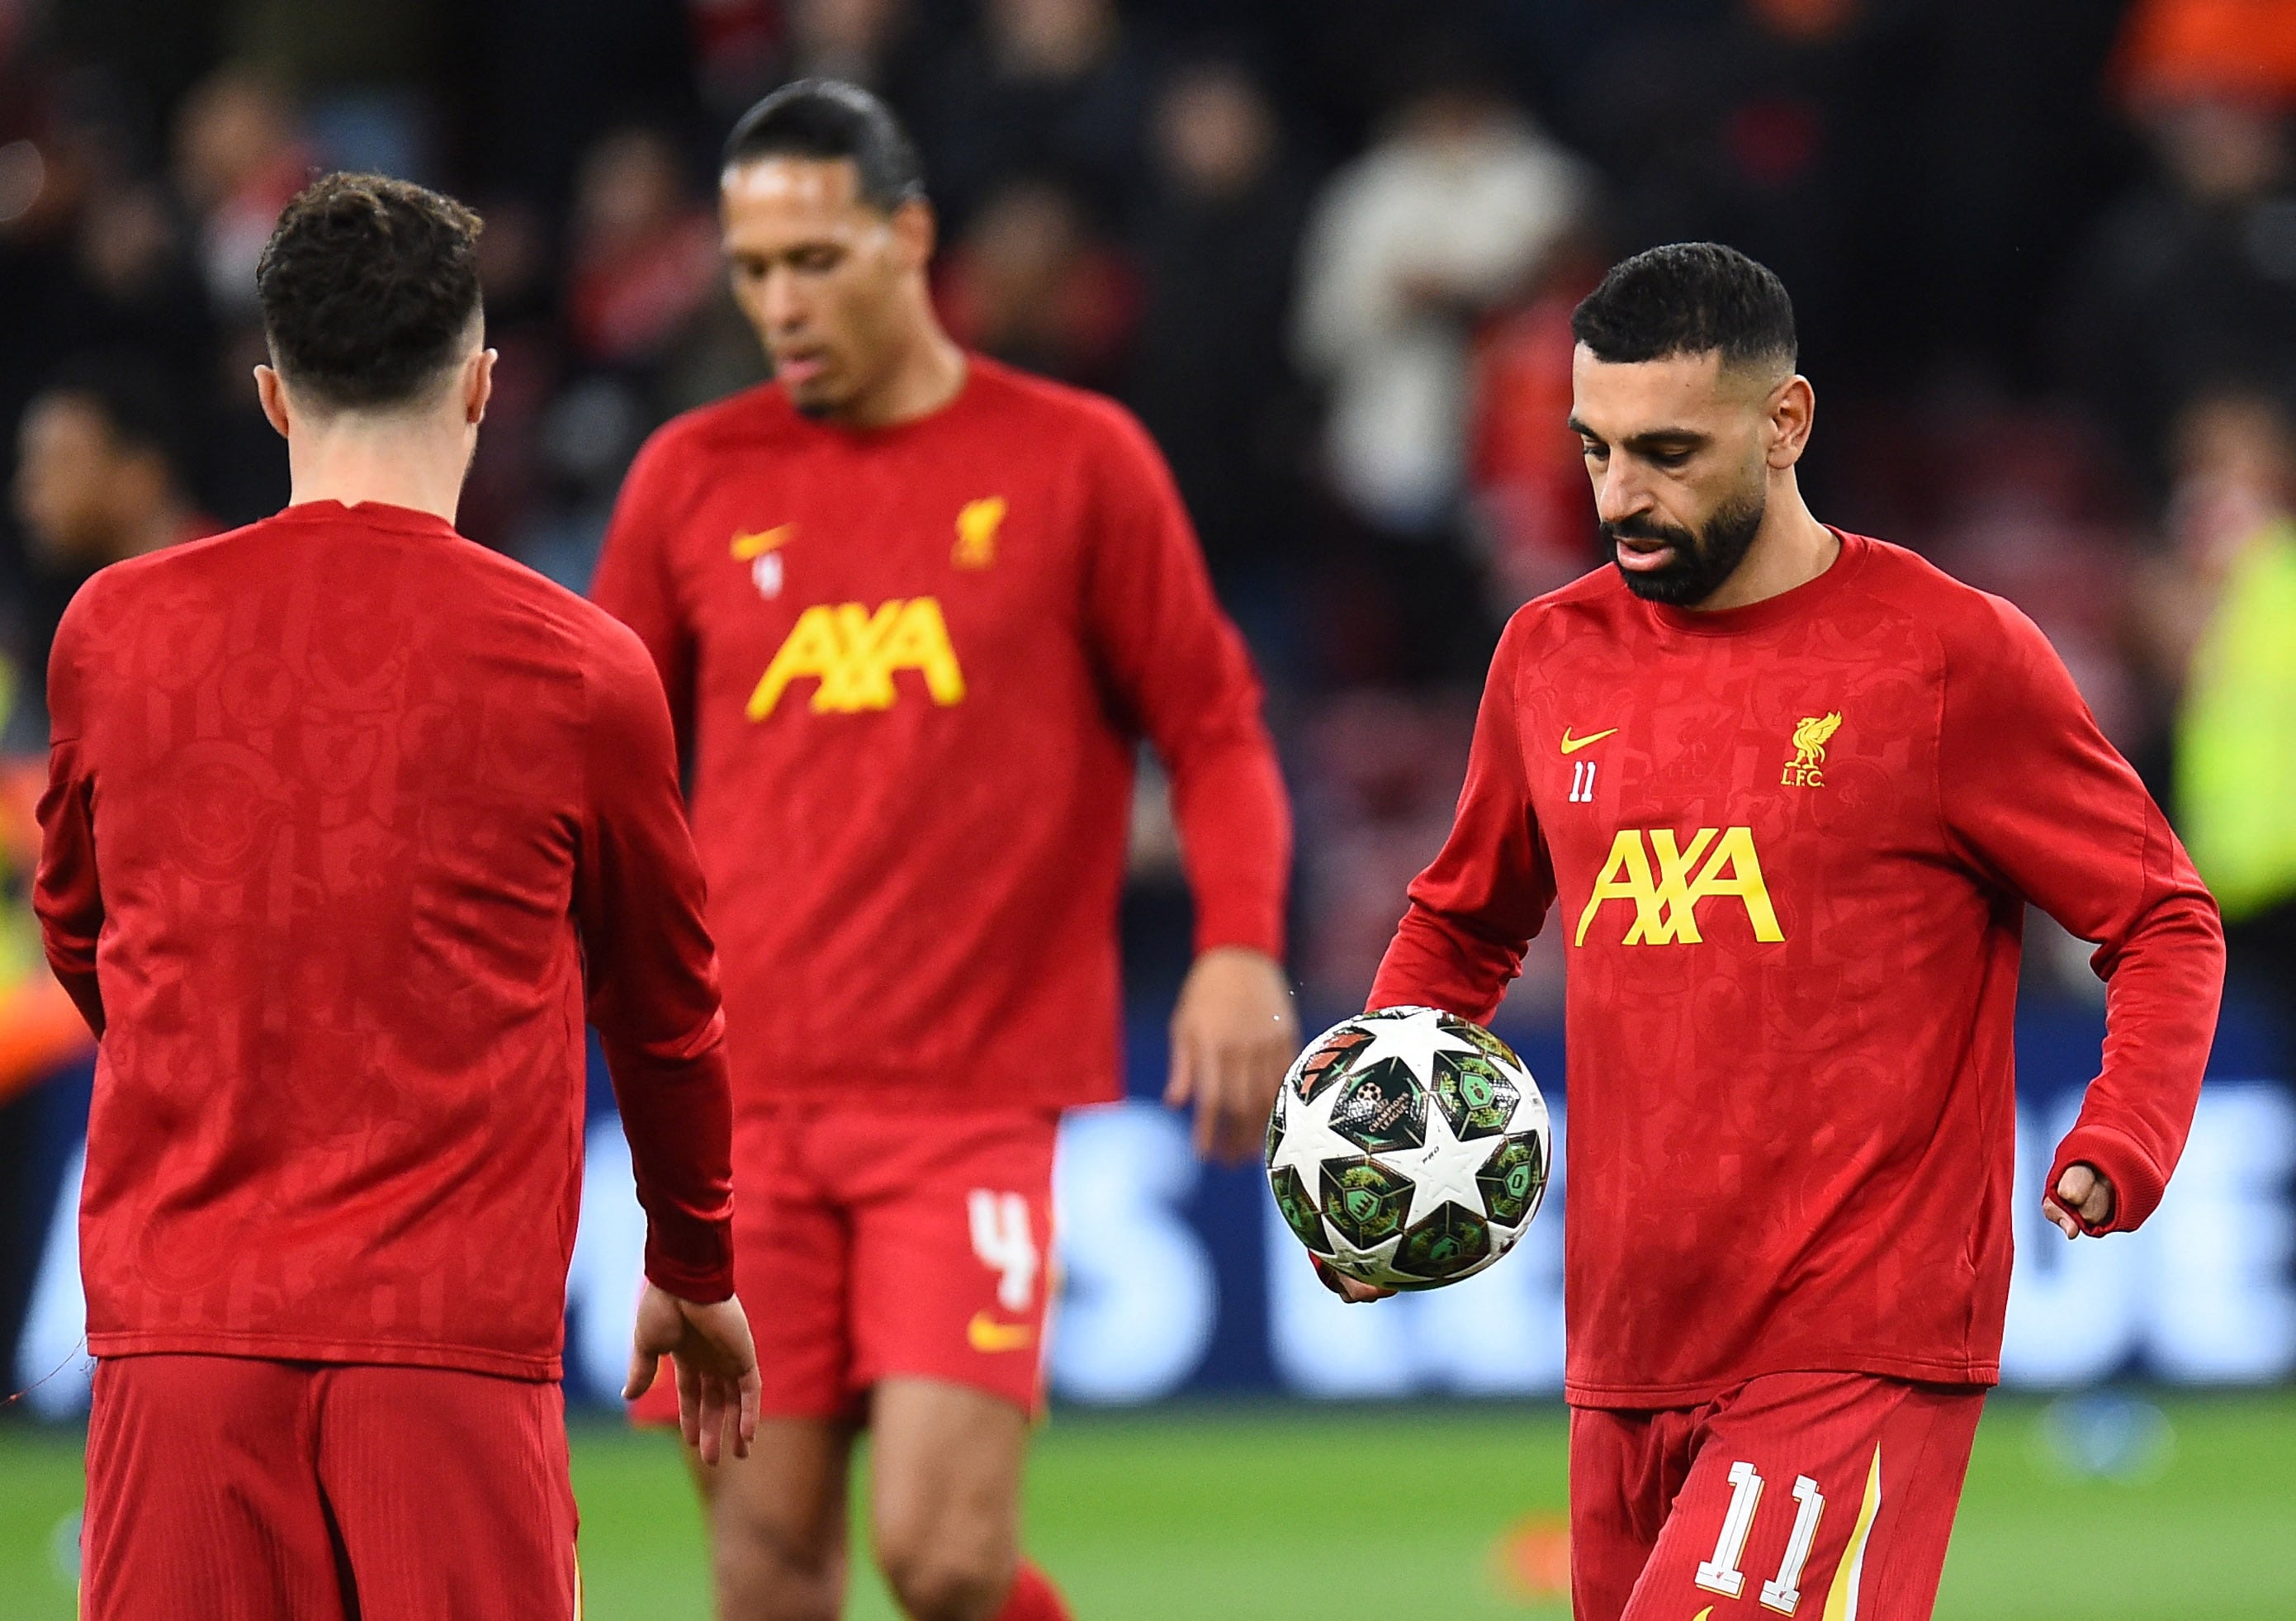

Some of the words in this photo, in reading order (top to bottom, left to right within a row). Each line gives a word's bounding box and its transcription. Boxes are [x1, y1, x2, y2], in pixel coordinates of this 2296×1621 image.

[746, 597, 966, 723] AXA
[1568, 761, 1596, 803] 11
[1574, 827, 1786, 947] AXA
[1369, 1092, 1409, 1133] CHAMPIONS
[1380, 1104, 1408, 1131] LEAGUE
[1422, 1145, 1440, 1165] PRO
[967, 1187, 1040, 1314] 4
[1694, 1461, 1825, 1618] 11
